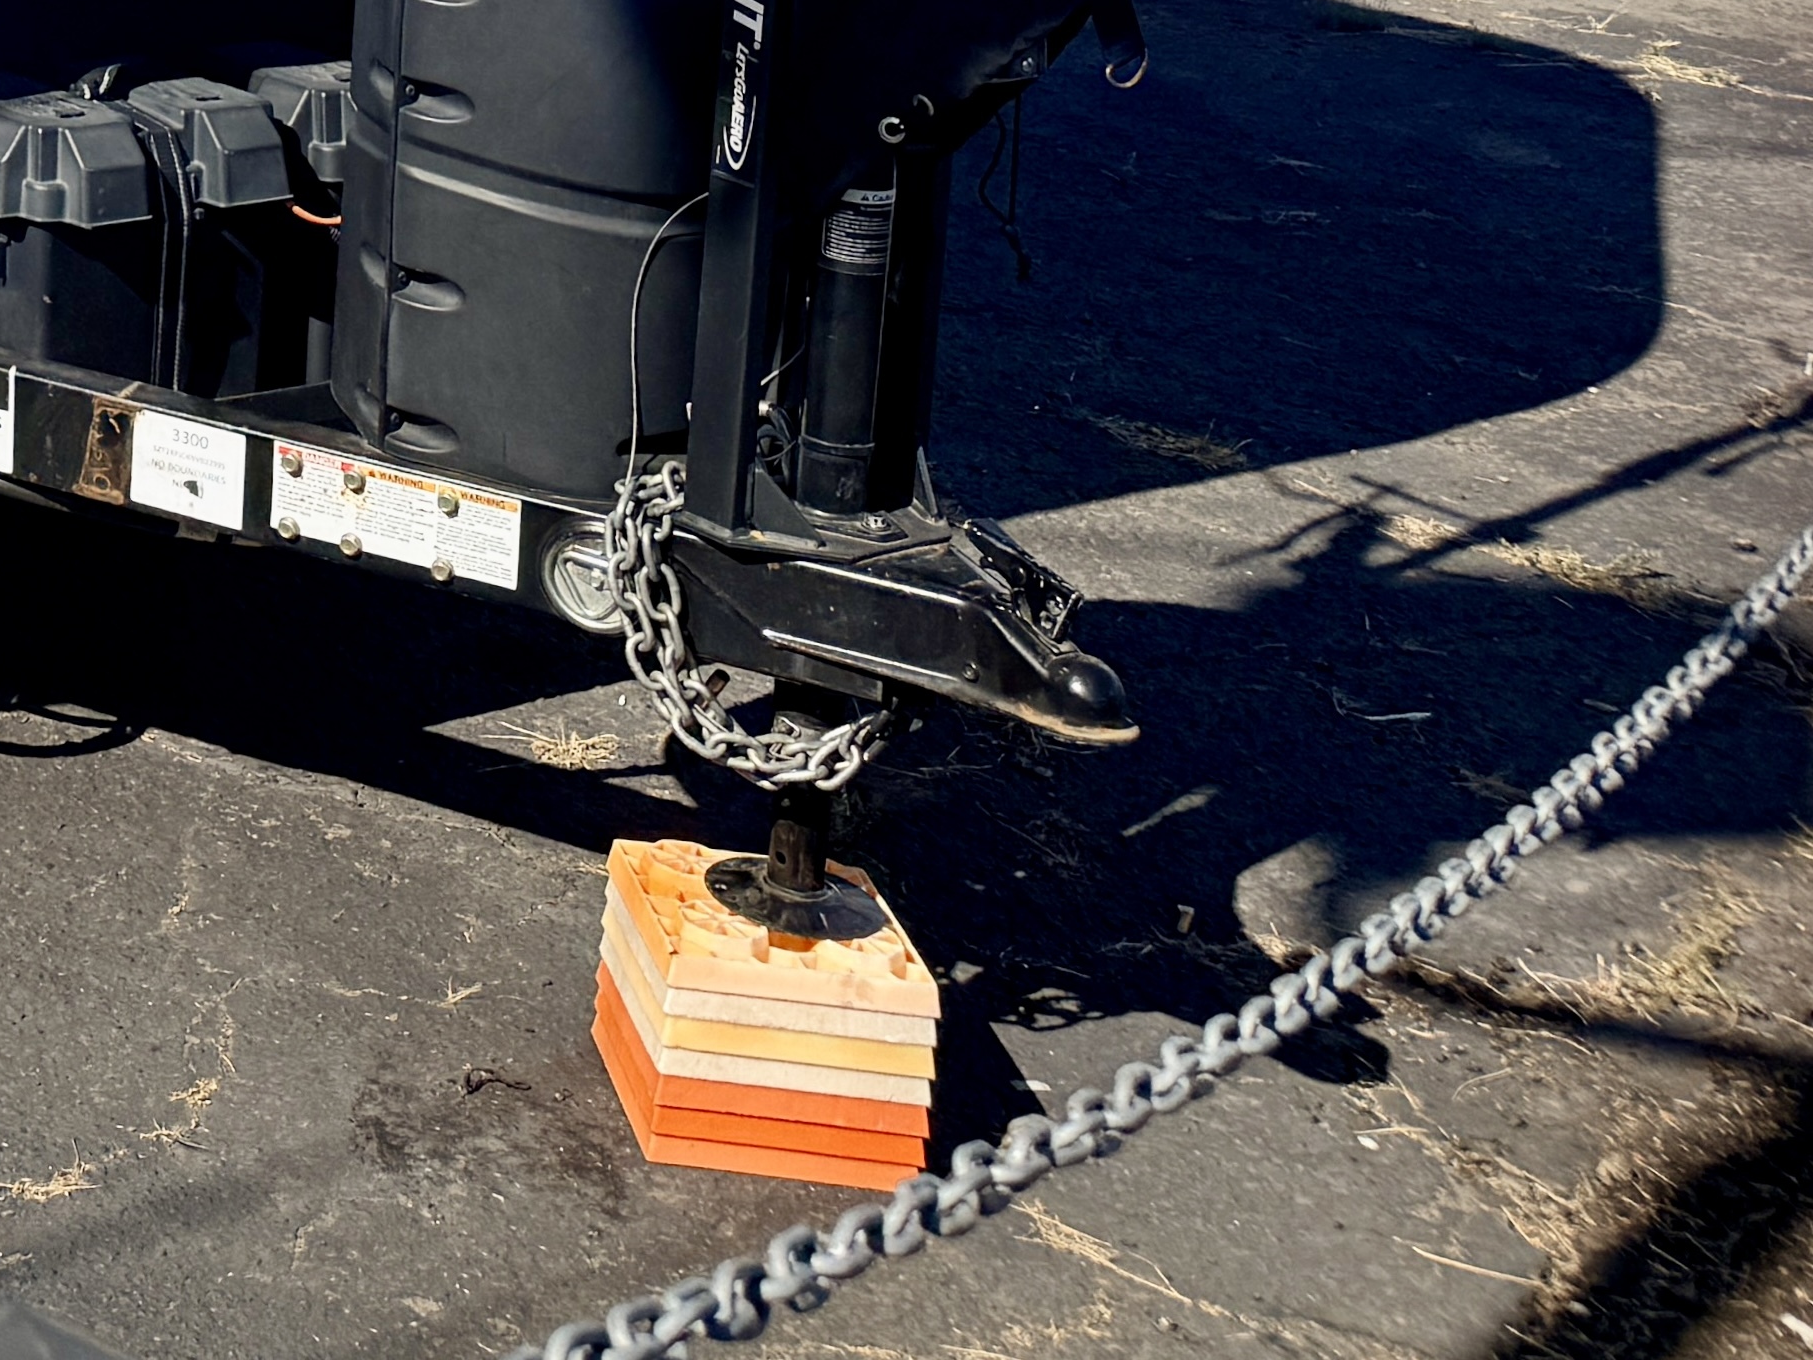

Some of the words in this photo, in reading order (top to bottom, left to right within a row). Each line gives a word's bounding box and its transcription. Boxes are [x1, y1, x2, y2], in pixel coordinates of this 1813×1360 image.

[173, 428, 209, 450] 3300
[379, 471, 424, 489] WARNING
[460, 491, 506, 510] WARNING
